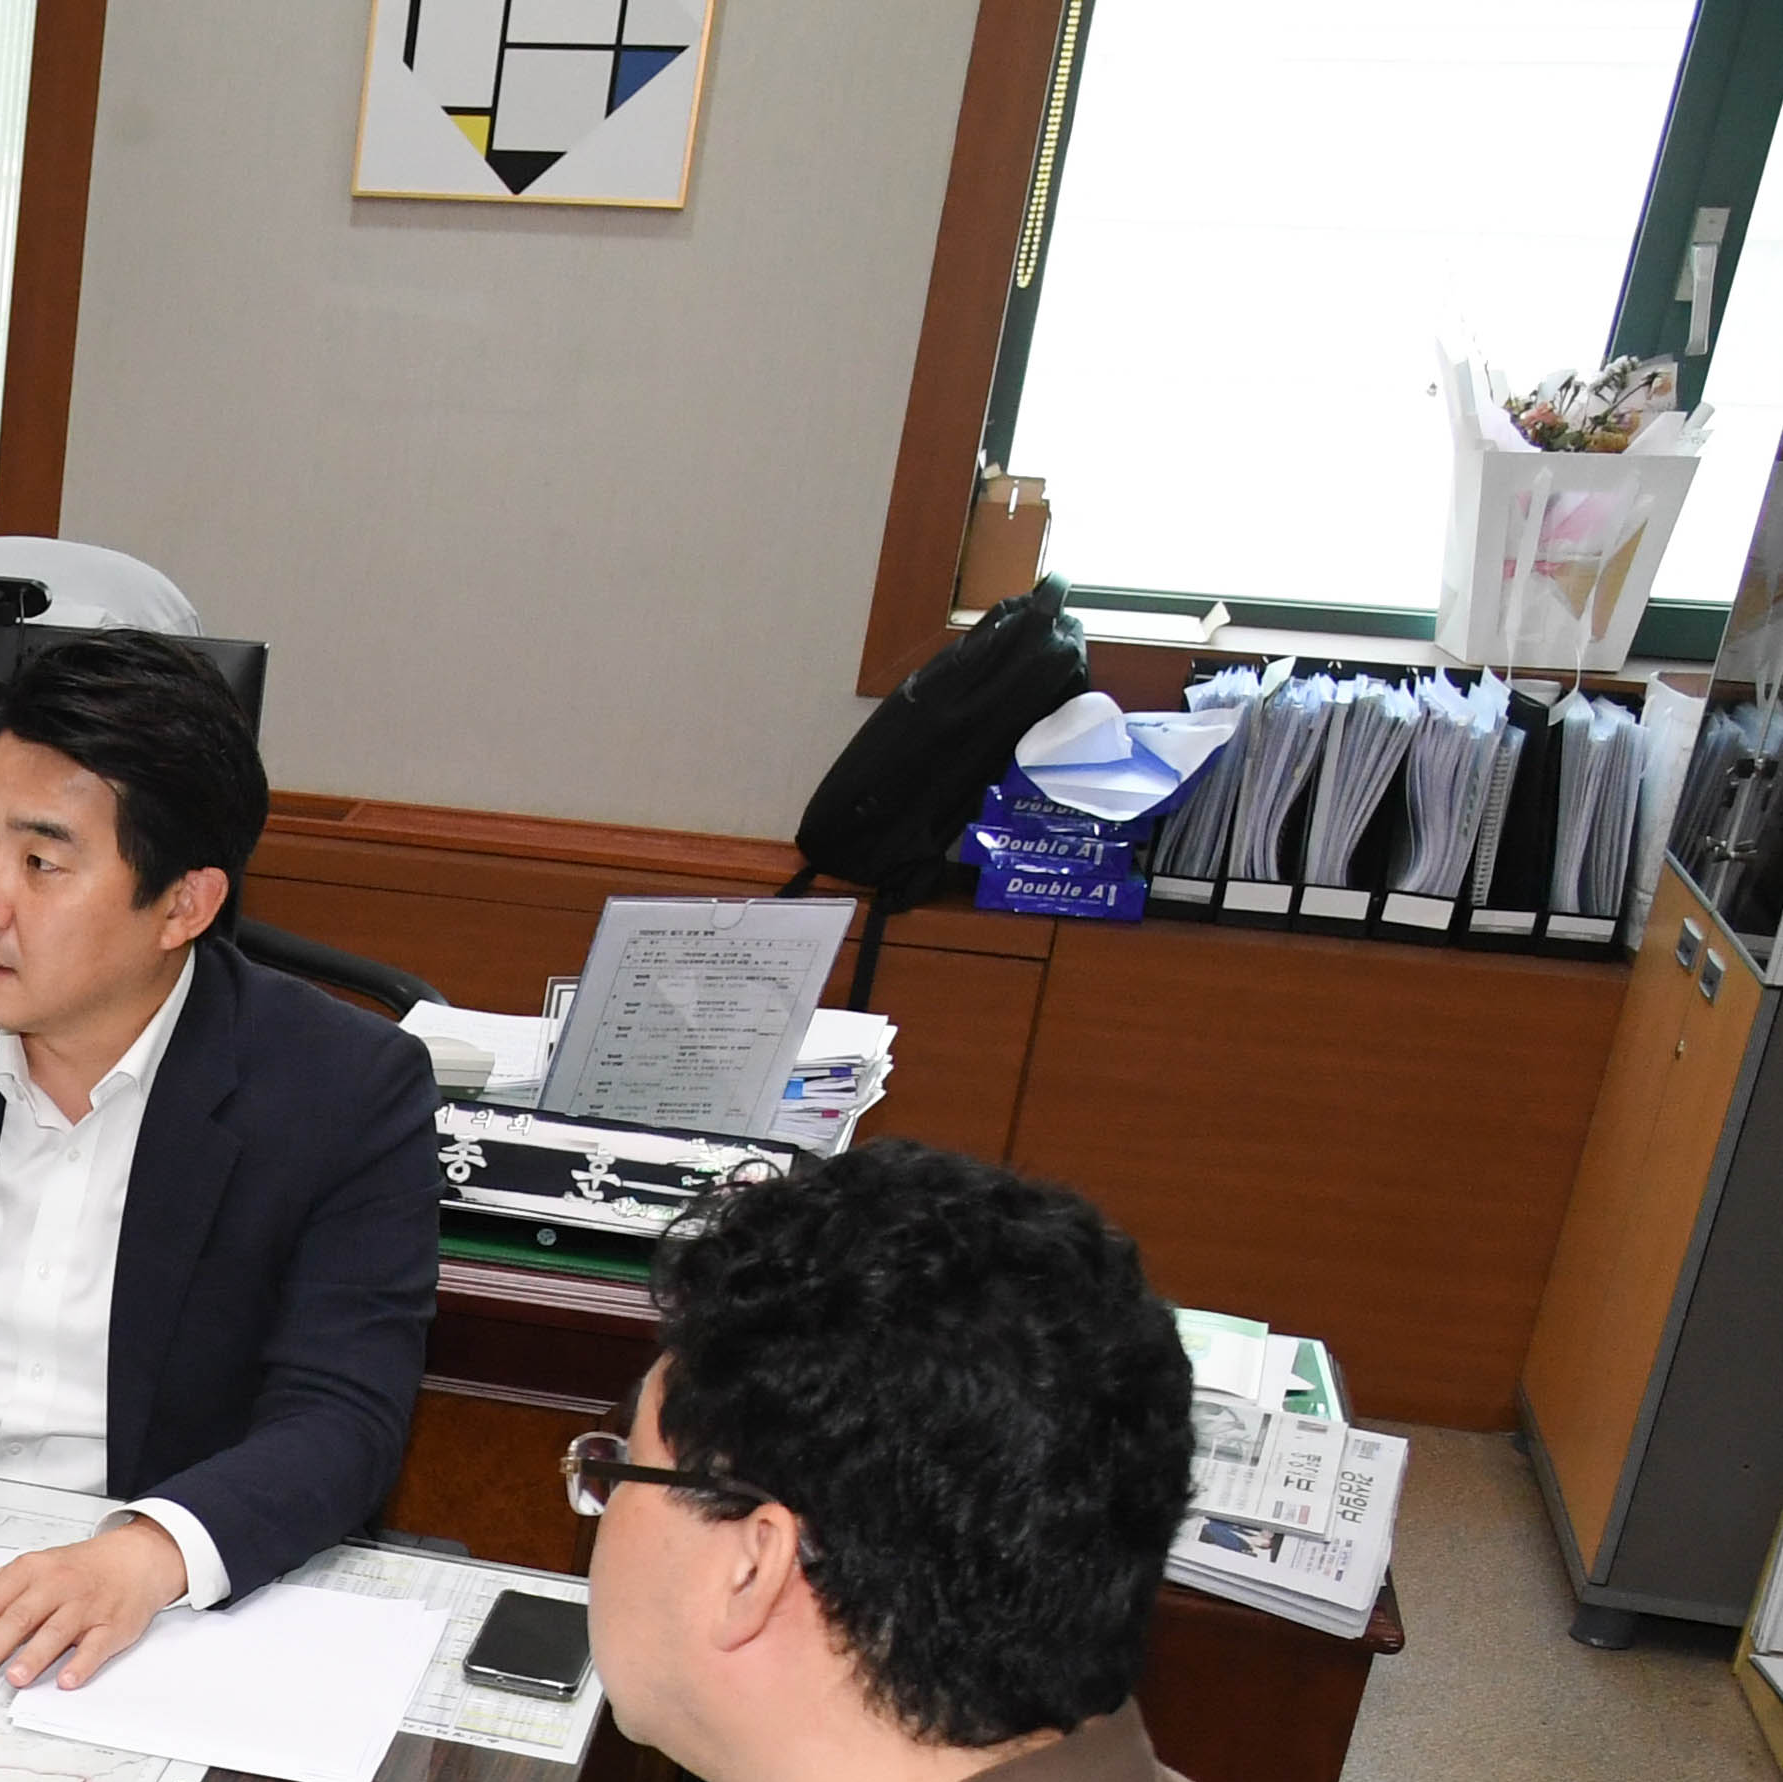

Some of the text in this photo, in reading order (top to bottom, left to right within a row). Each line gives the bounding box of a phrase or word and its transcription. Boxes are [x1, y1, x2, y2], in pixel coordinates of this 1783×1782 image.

[996, 834, 1092, 858] Double A
[1006, 877, 1108, 899] Double A
[1337, 1470, 1373, 1523] 경상일보
